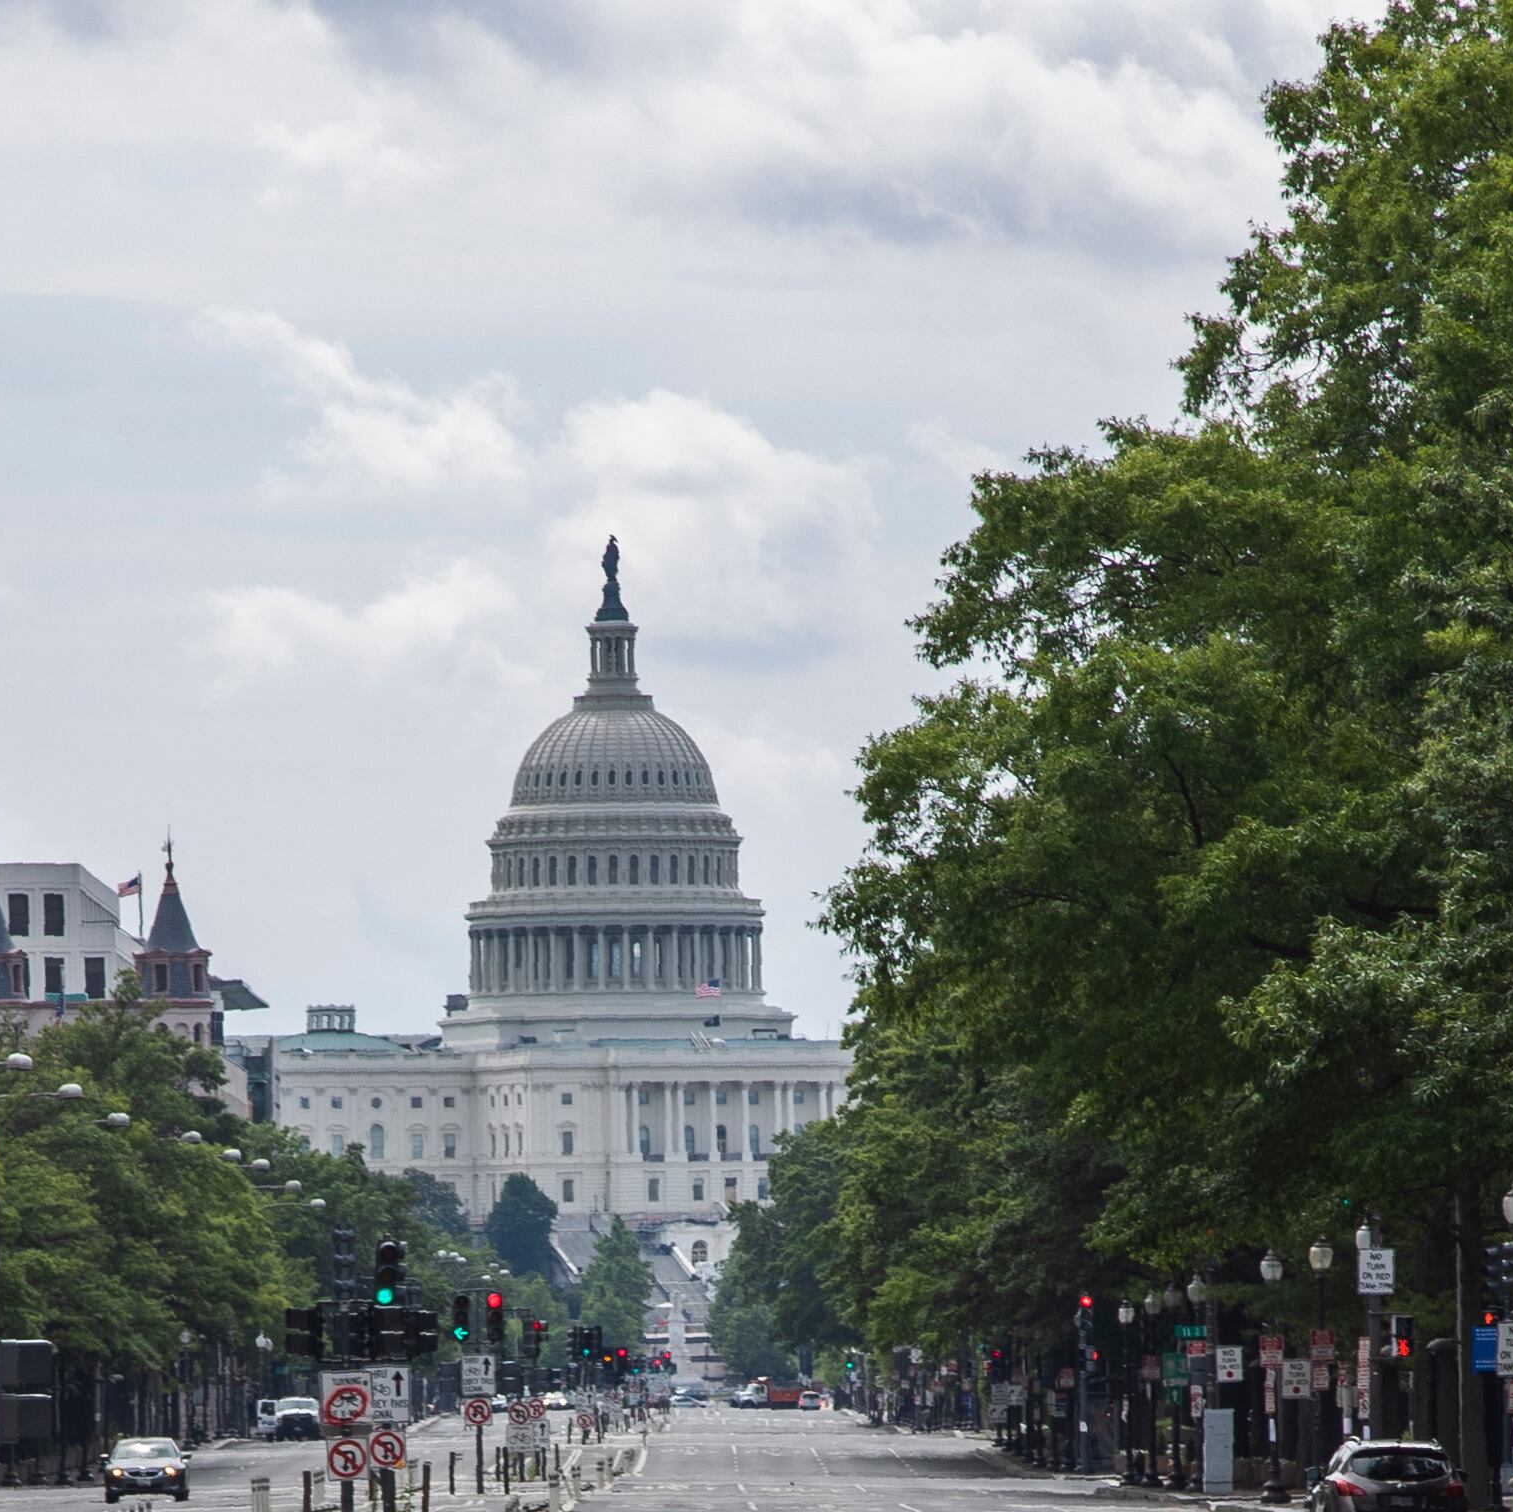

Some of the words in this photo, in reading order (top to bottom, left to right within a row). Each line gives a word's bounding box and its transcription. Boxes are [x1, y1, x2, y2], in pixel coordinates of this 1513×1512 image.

[1370, 1252, 1382, 1260] NO
[1222, 1349, 1235, 1357] NO
[1500, 1351, 1511, 1360] ON
